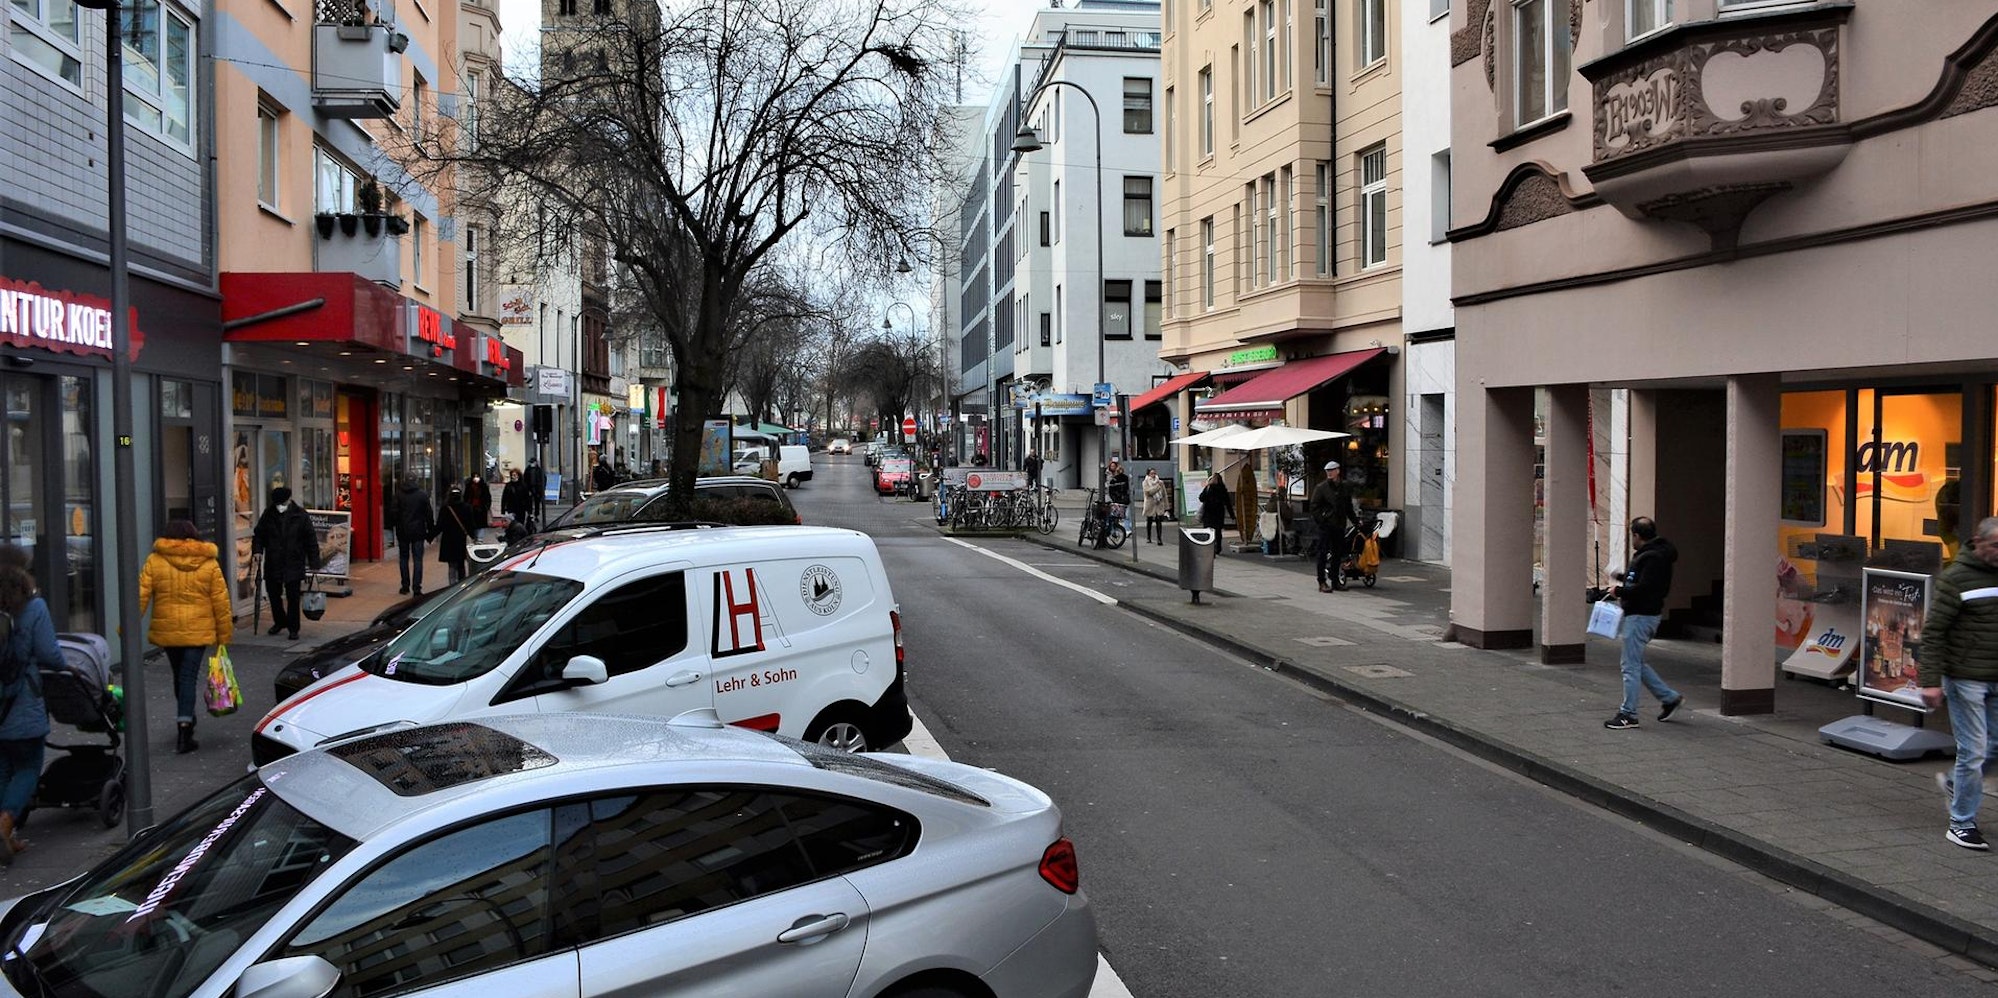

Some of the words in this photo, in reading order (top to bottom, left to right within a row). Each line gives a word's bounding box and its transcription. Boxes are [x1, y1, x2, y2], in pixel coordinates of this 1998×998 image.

[1622, 88, 1655, 123] 1903
[1110, 313, 1123, 322] sky
[120, 436, 132, 446] 16
[1856, 428, 1919, 473] dm
[1818, 628, 1846, 648] dm
[716, 678, 746, 694] Lehr
[750, 673, 761, 687] &
[764, 668, 797, 684] Sohn
